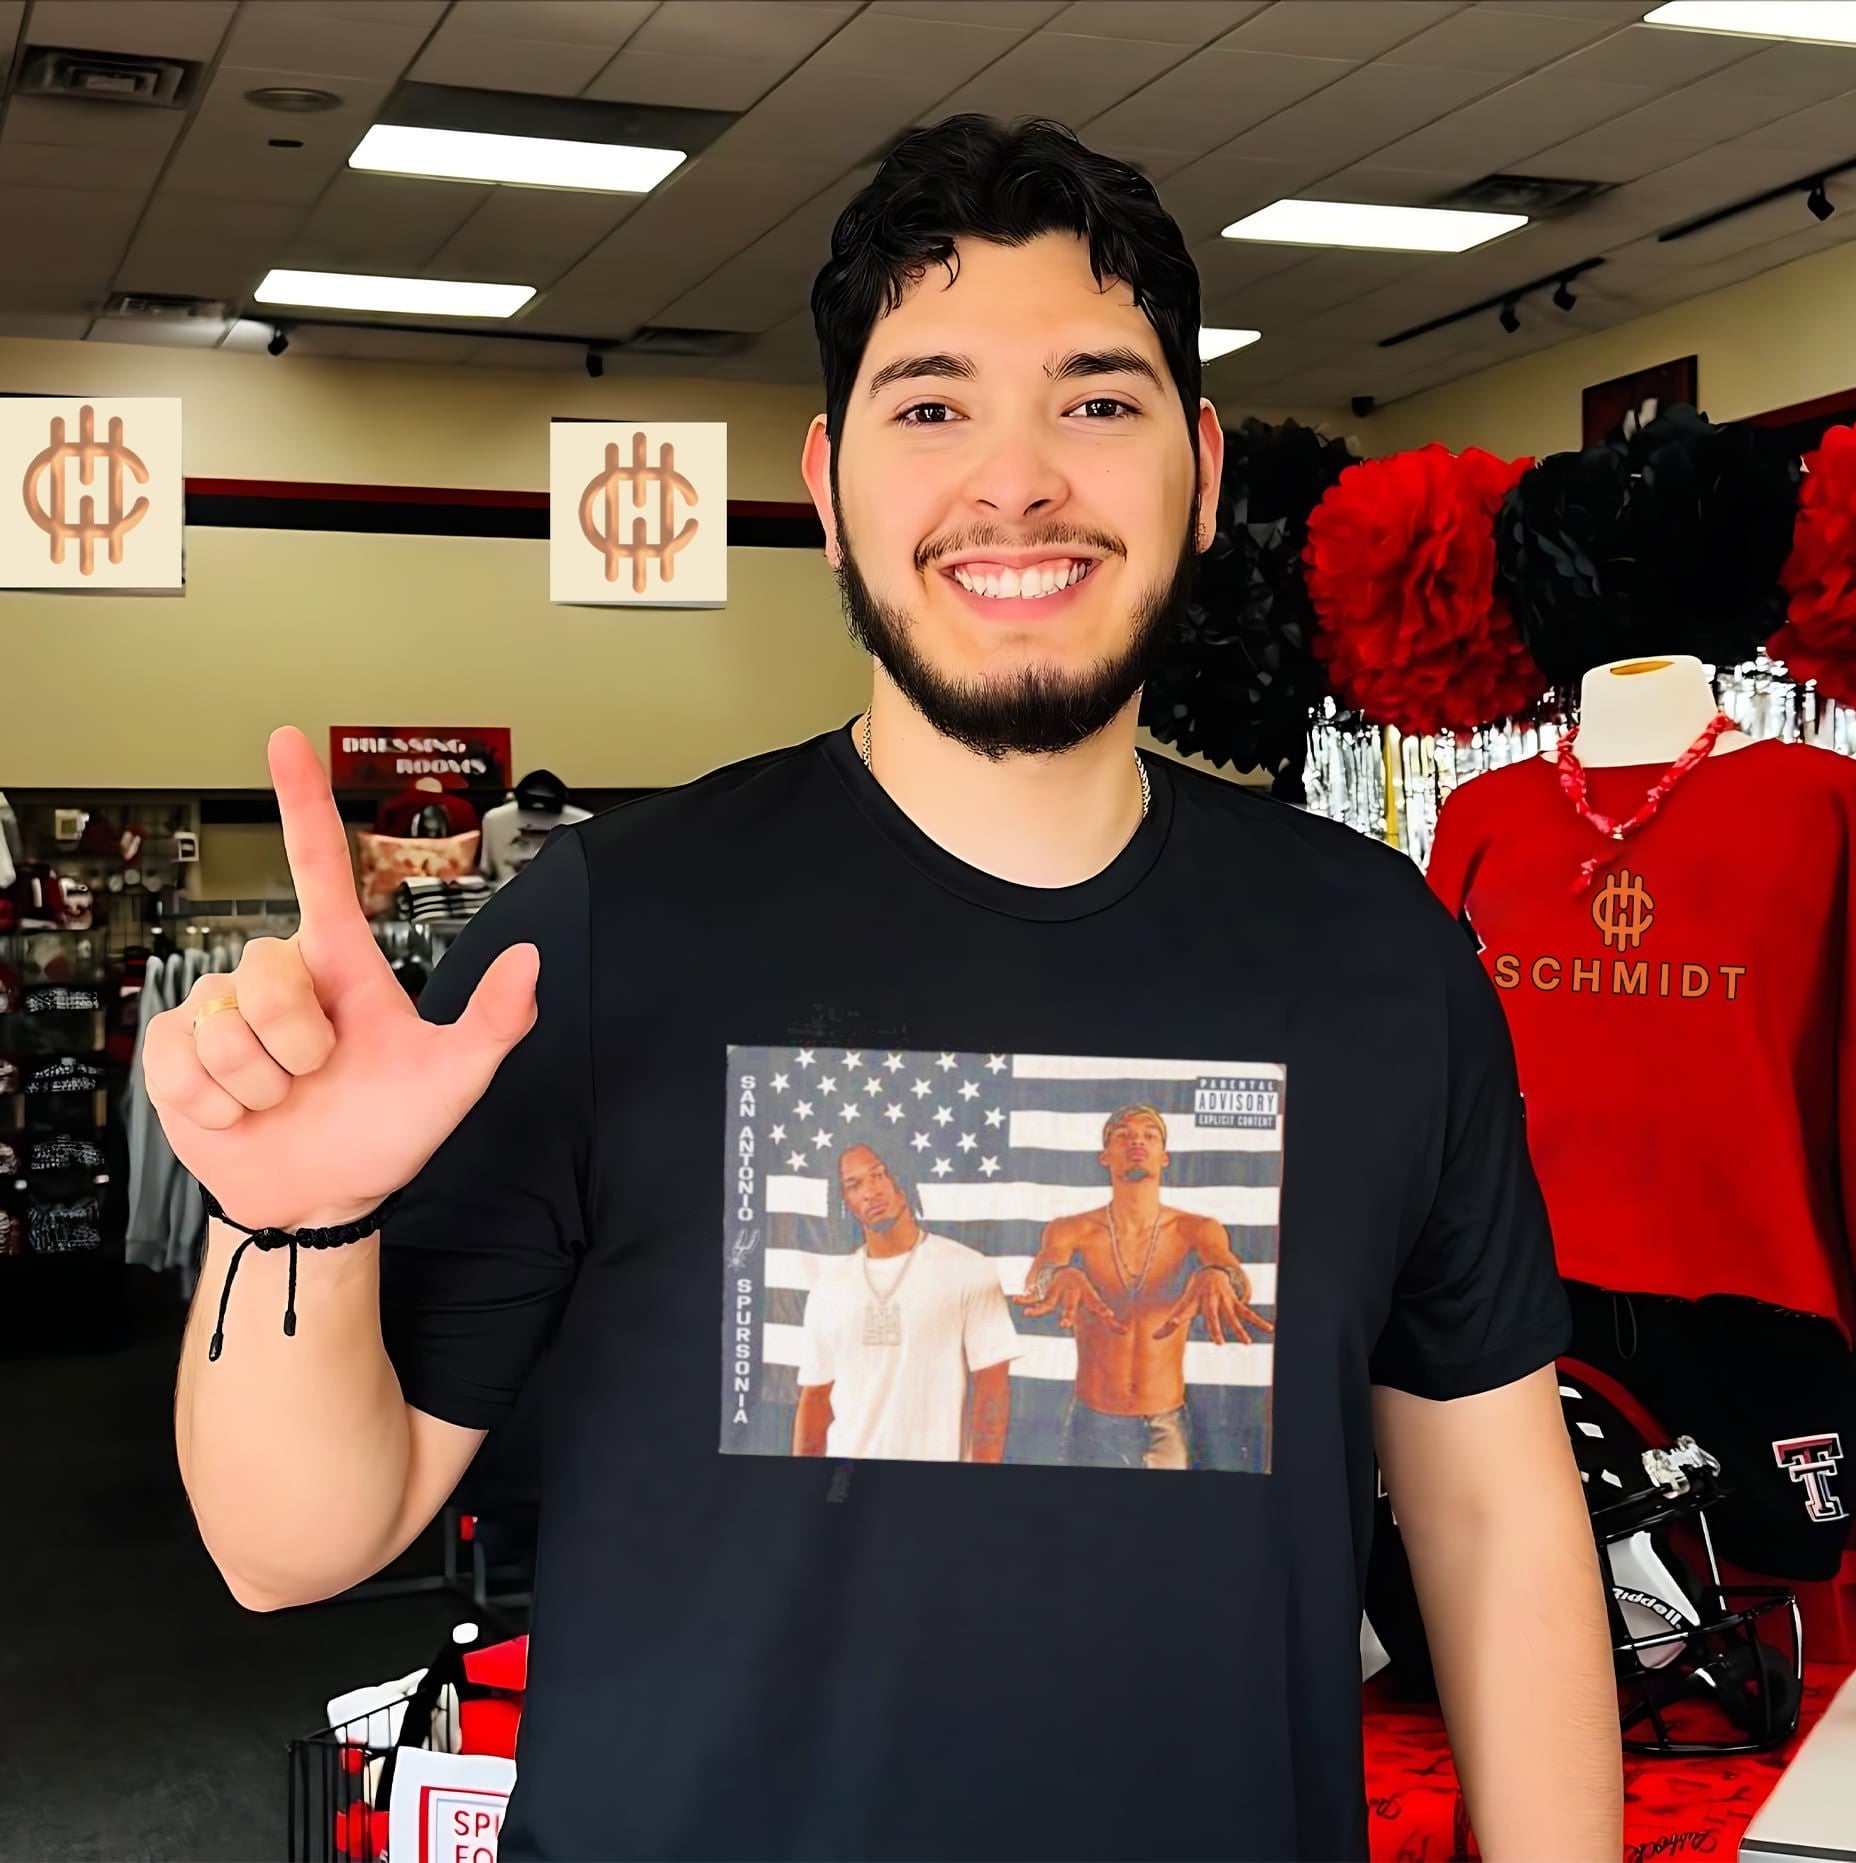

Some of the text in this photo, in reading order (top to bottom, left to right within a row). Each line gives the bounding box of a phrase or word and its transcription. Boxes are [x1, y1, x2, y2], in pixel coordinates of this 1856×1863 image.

[396, 758, 487, 775] ROOMS
[1493, 953, 1747, 1000] SCHMIDT
[1200, 1079, 1274, 1091] PARENTAL
[1198, 1092, 1274, 1112] ADVISORY
[1198, 1114, 1273, 1127] EXPLICIT CONTENT
[733, 1075, 756, 1424] SAN ANTONIO SPURSONIA
